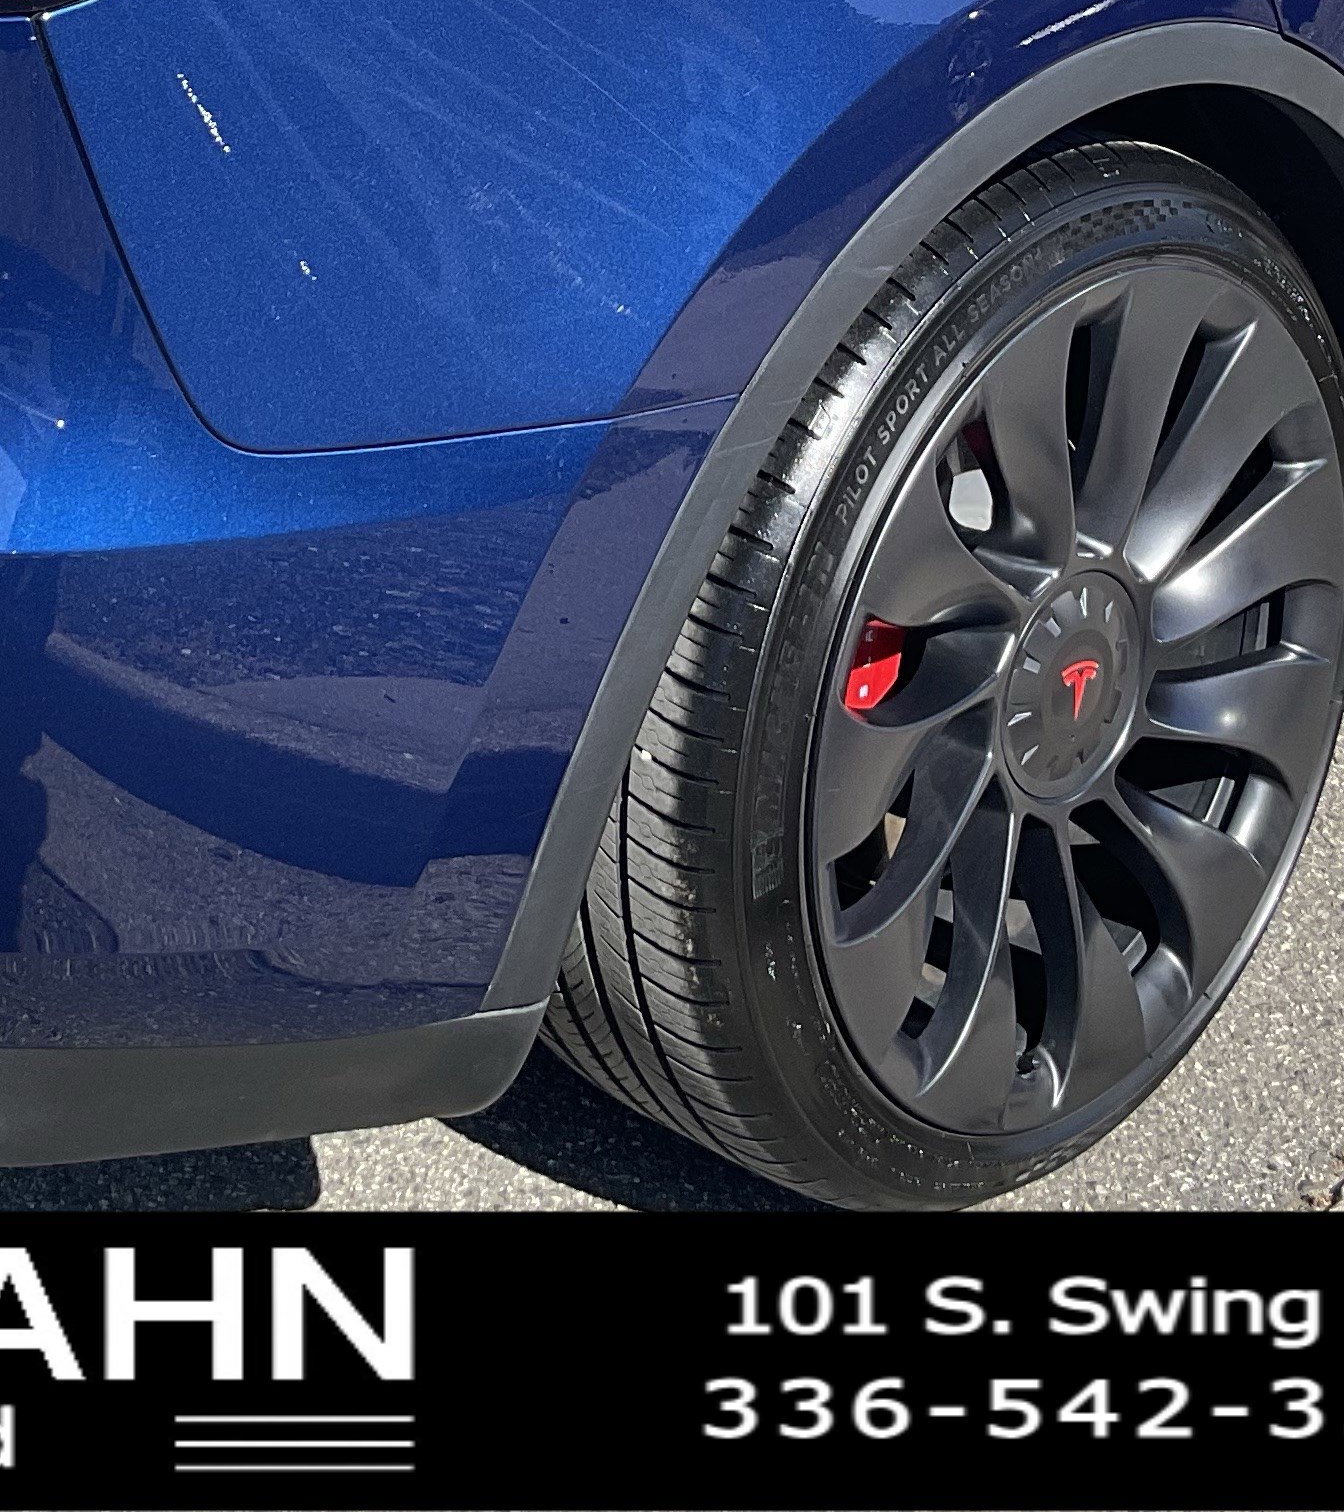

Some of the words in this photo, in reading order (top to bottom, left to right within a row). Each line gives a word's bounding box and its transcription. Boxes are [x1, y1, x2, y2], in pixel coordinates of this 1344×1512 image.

[834, 446, 881, 526] PILOT
[877, 363, 928, 445] SPORT
[932, 325, 966, 368] ALL
[966, 247, 1042, 323] SEASON
